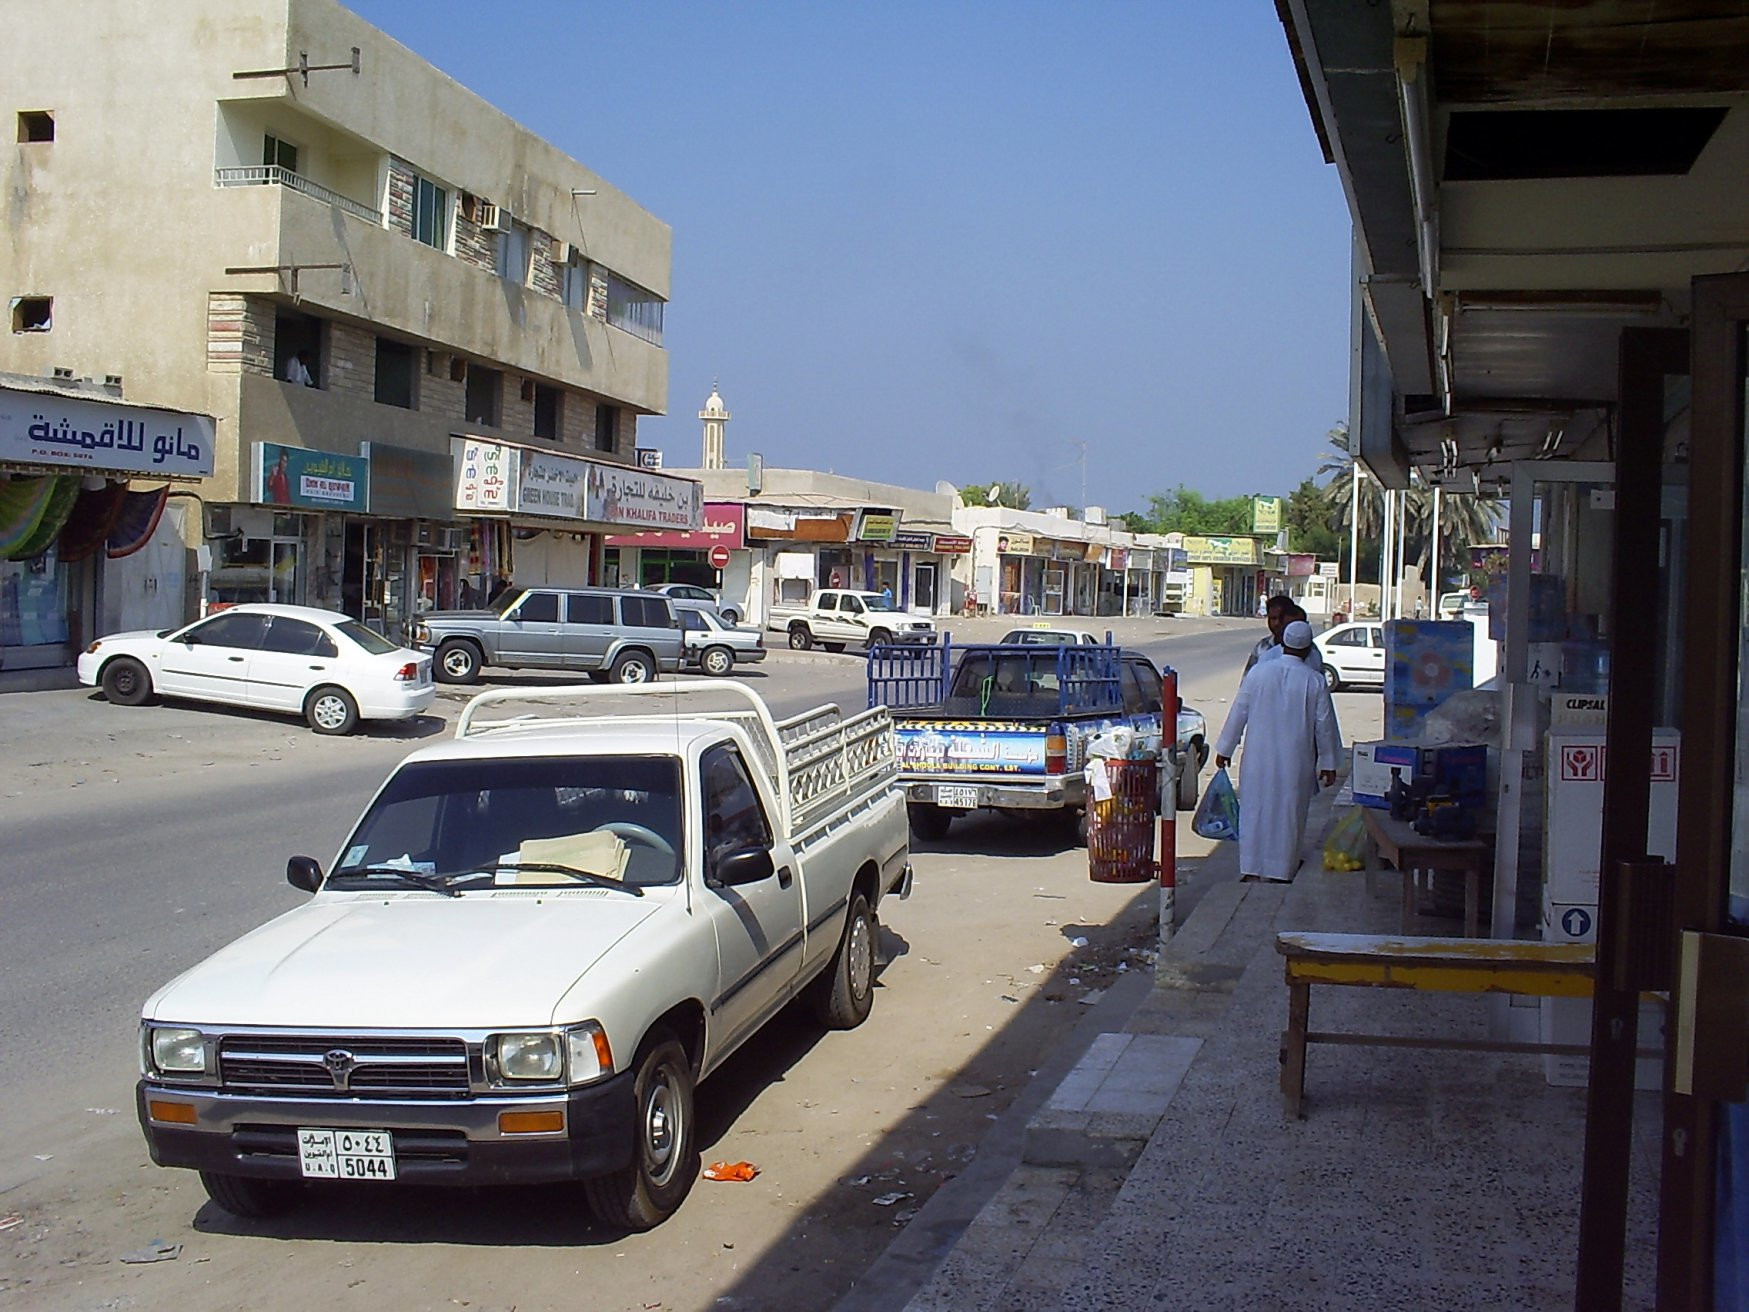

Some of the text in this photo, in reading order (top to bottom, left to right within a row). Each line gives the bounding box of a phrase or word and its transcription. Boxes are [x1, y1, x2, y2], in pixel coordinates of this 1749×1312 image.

[28, 414, 200, 464] مانو للاقمشة
[626, 507, 657, 521] KHALIFA
[659, 511, 689, 525] TRADERS
[1566, 698, 1605, 711] CLIPSAL
[345, 1157, 388, 1178] 5044
